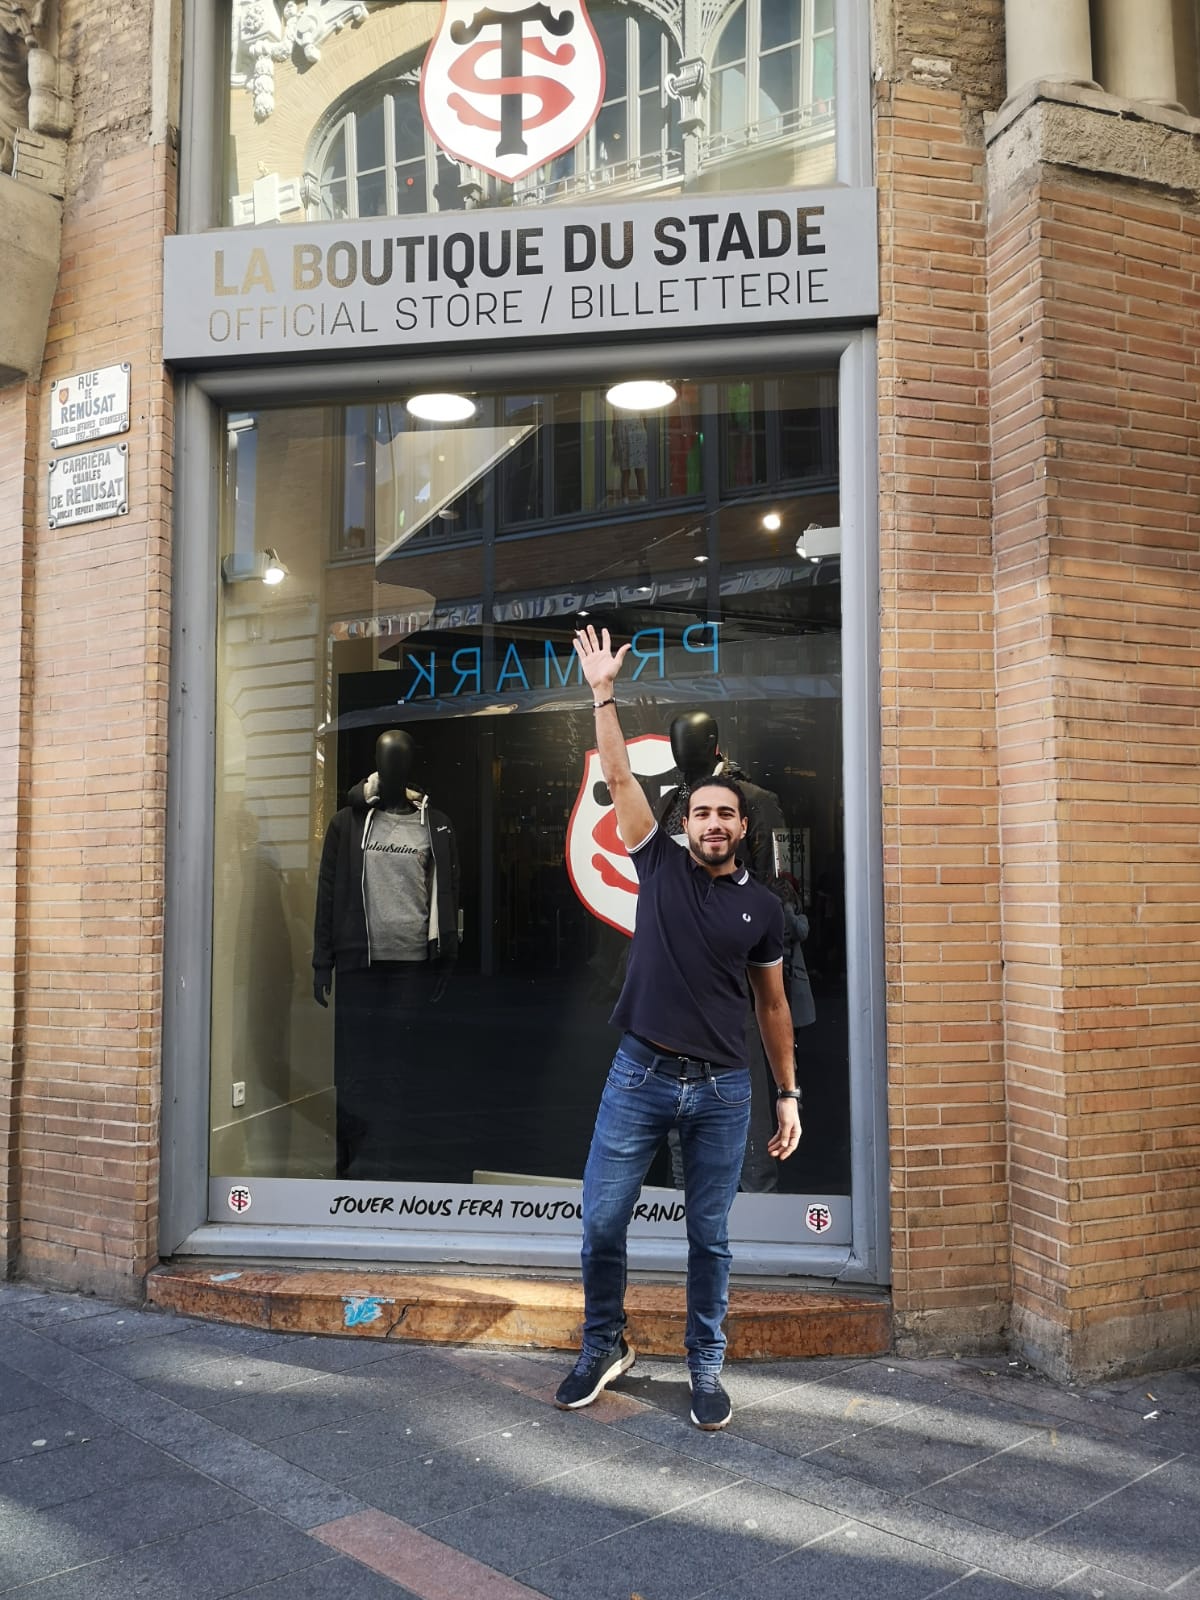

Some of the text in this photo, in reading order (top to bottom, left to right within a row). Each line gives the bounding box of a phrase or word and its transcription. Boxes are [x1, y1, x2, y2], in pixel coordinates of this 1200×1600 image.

[214, 205, 826, 296] LA BOUTIQUE DU STADE
[209, 268, 829, 342] OFFICIAL STORE / BILLETTERIE
[78, 372, 99, 390] RUE
[84, 387, 93, 399] DE
[61, 392, 116, 425] REMUSAT
[51, 476, 124, 510] DE REMUSAT
[366, 841, 419, 855] ulousaine
[330, 1195, 686, 1222] JOUER NOUS FERA TOUJO RAND
